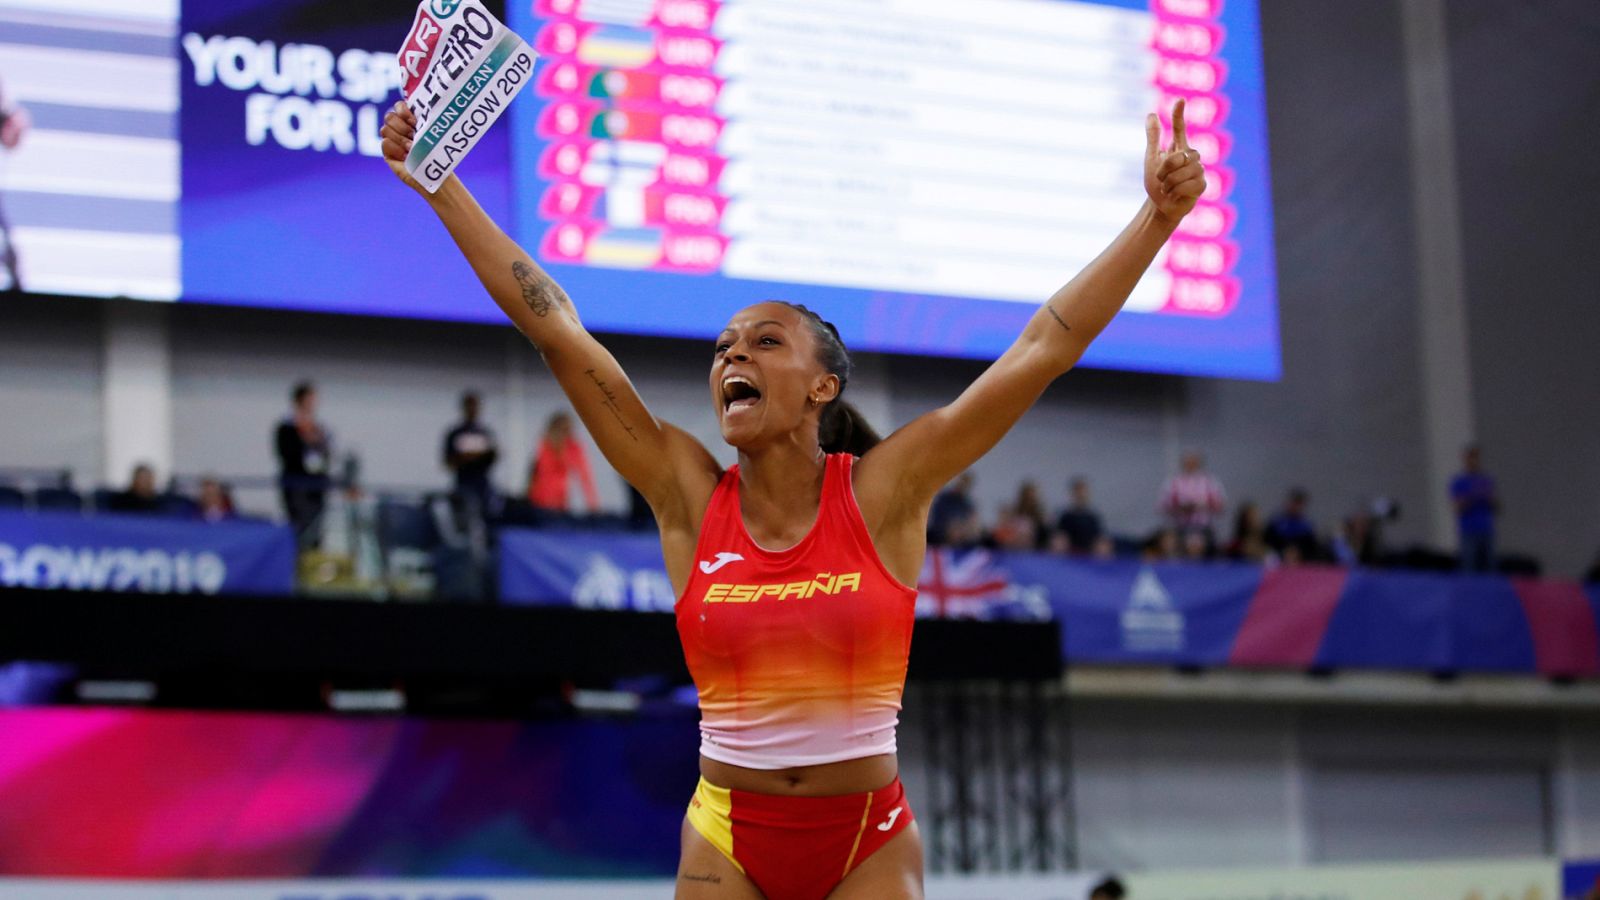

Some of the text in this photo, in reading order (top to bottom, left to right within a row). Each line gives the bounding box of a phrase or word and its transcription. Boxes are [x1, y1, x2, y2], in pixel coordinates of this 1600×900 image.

[182, 32, 337, 98] YOUR
[245, 92, 355, 154] FOR
[424, 136, 434, 145] I
[430, 106, 458, 138] RUN
[425, 53, 532, 181] GLASGOW 2019
[703, 572, 861, 603] ESPAÑA
